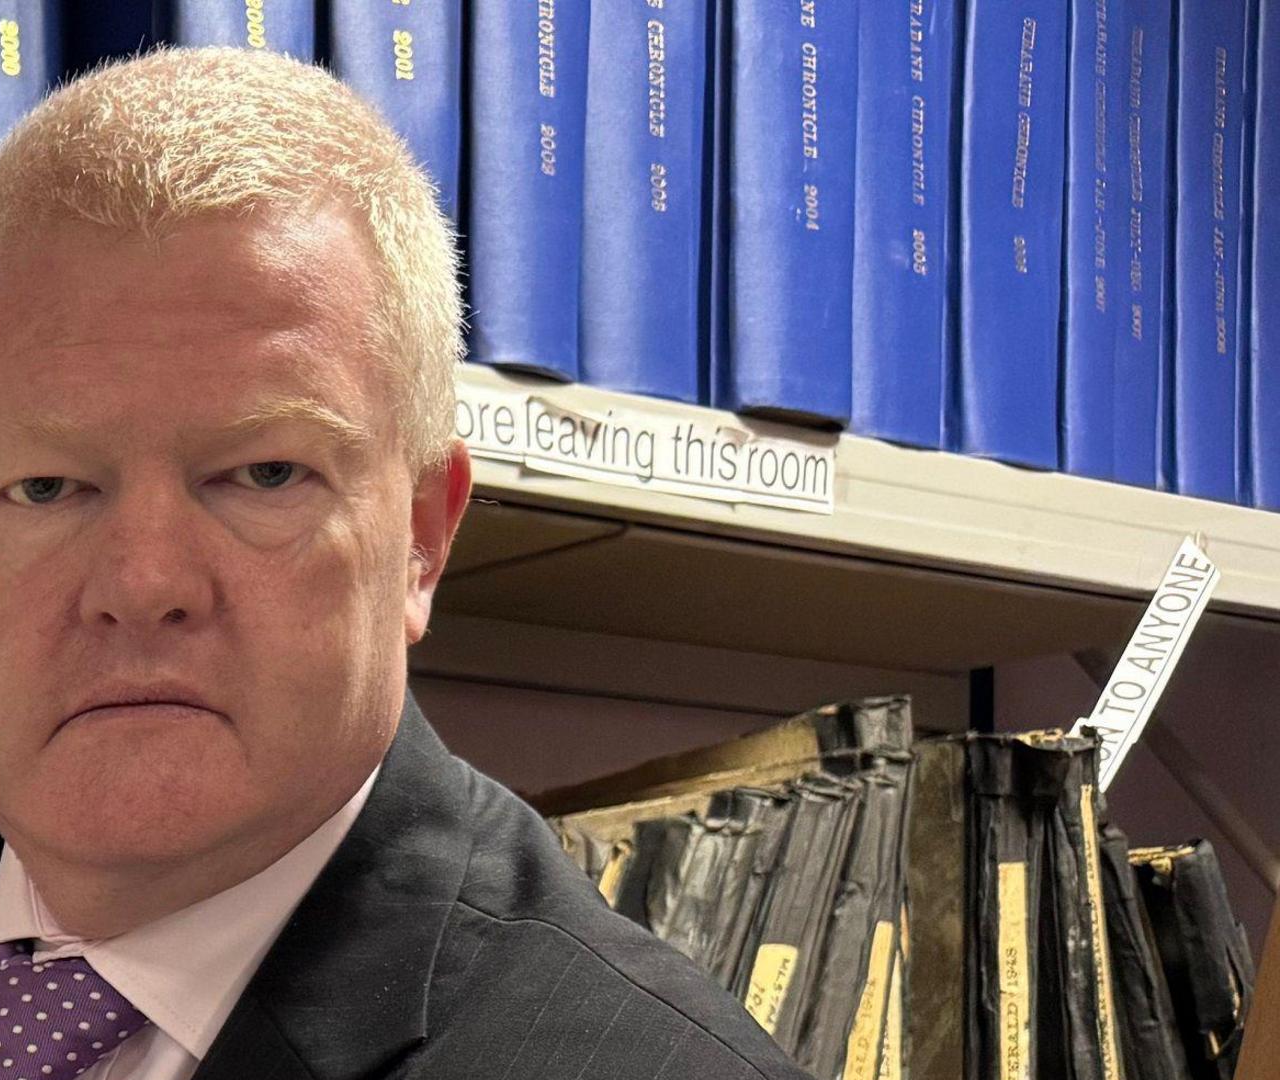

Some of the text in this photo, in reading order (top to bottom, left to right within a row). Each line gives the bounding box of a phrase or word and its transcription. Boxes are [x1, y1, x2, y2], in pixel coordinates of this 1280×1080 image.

[802, 42, 819, 231] CHRONICLE 2004
[912, 95, 925, 206] CHRONICLE
[526, 397, 654, 482] leaving
[673, 424, 737, 480] this
[744, 445, 828, 497] room
[1099, 681, 1146, 715] TO
[1127, 553, 1210, 673] ANYONE
